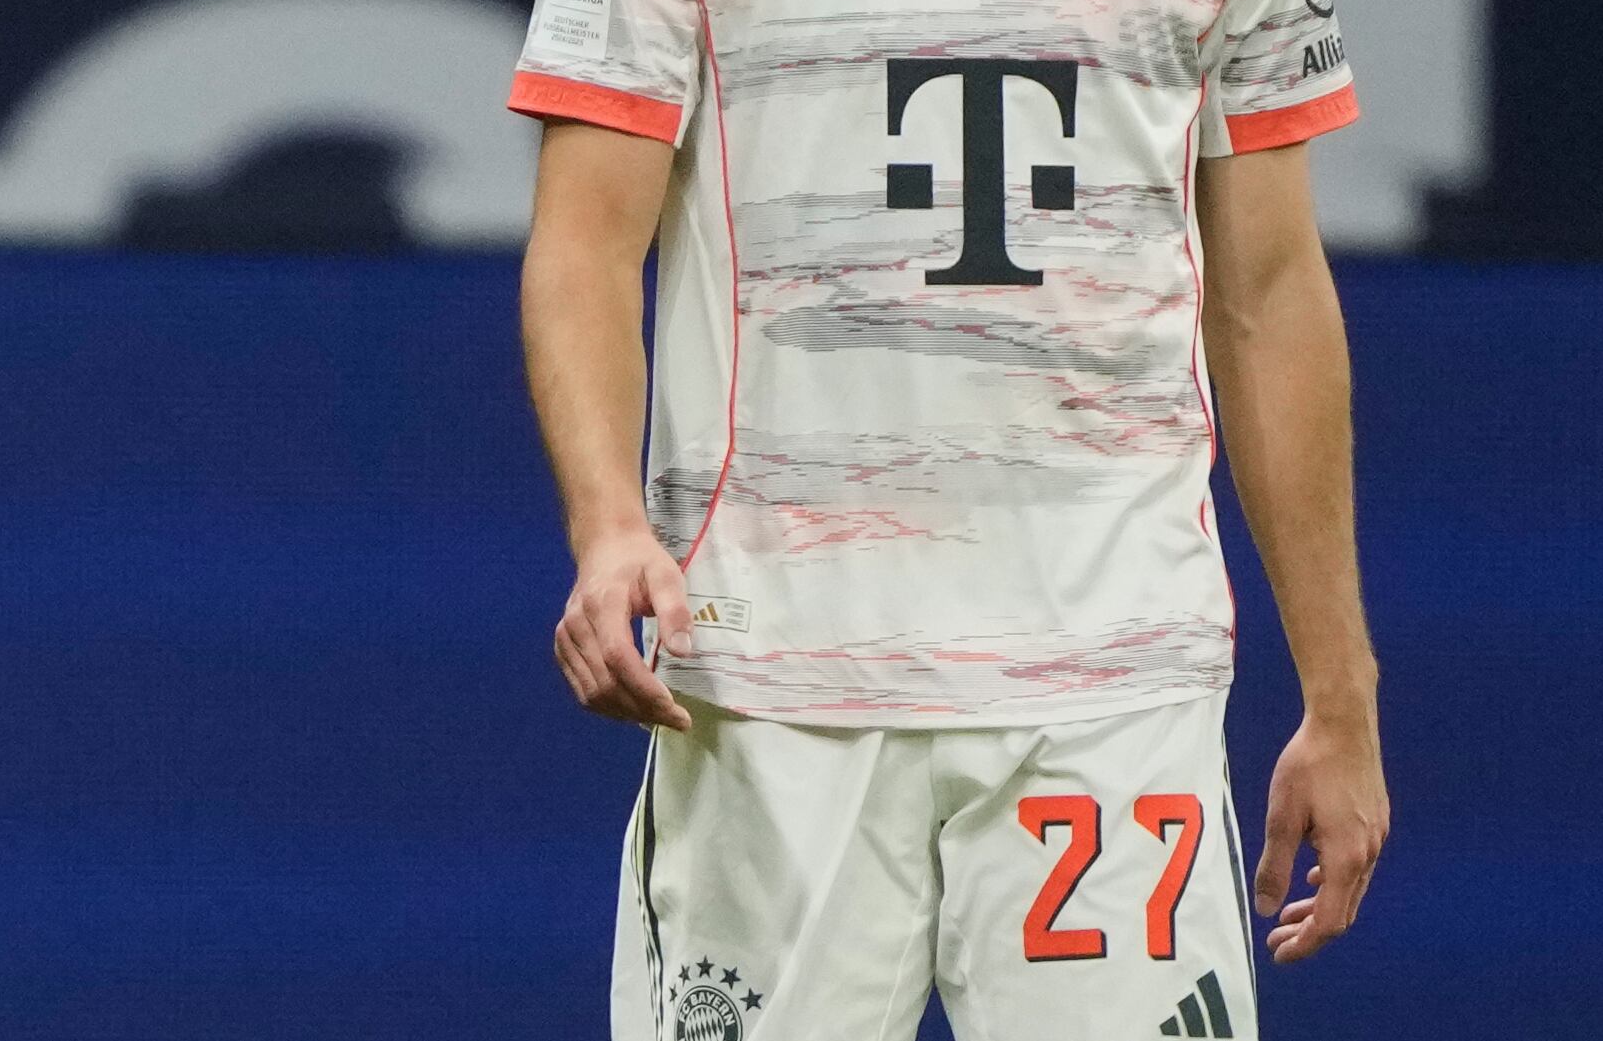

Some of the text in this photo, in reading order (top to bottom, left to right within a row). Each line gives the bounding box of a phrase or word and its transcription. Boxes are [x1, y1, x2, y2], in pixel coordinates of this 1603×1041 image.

[887, 58, 1079, 286] T
[1017, 793, 1205, 963] 27
[679, 991, 736, 1027] FC BAYERN
